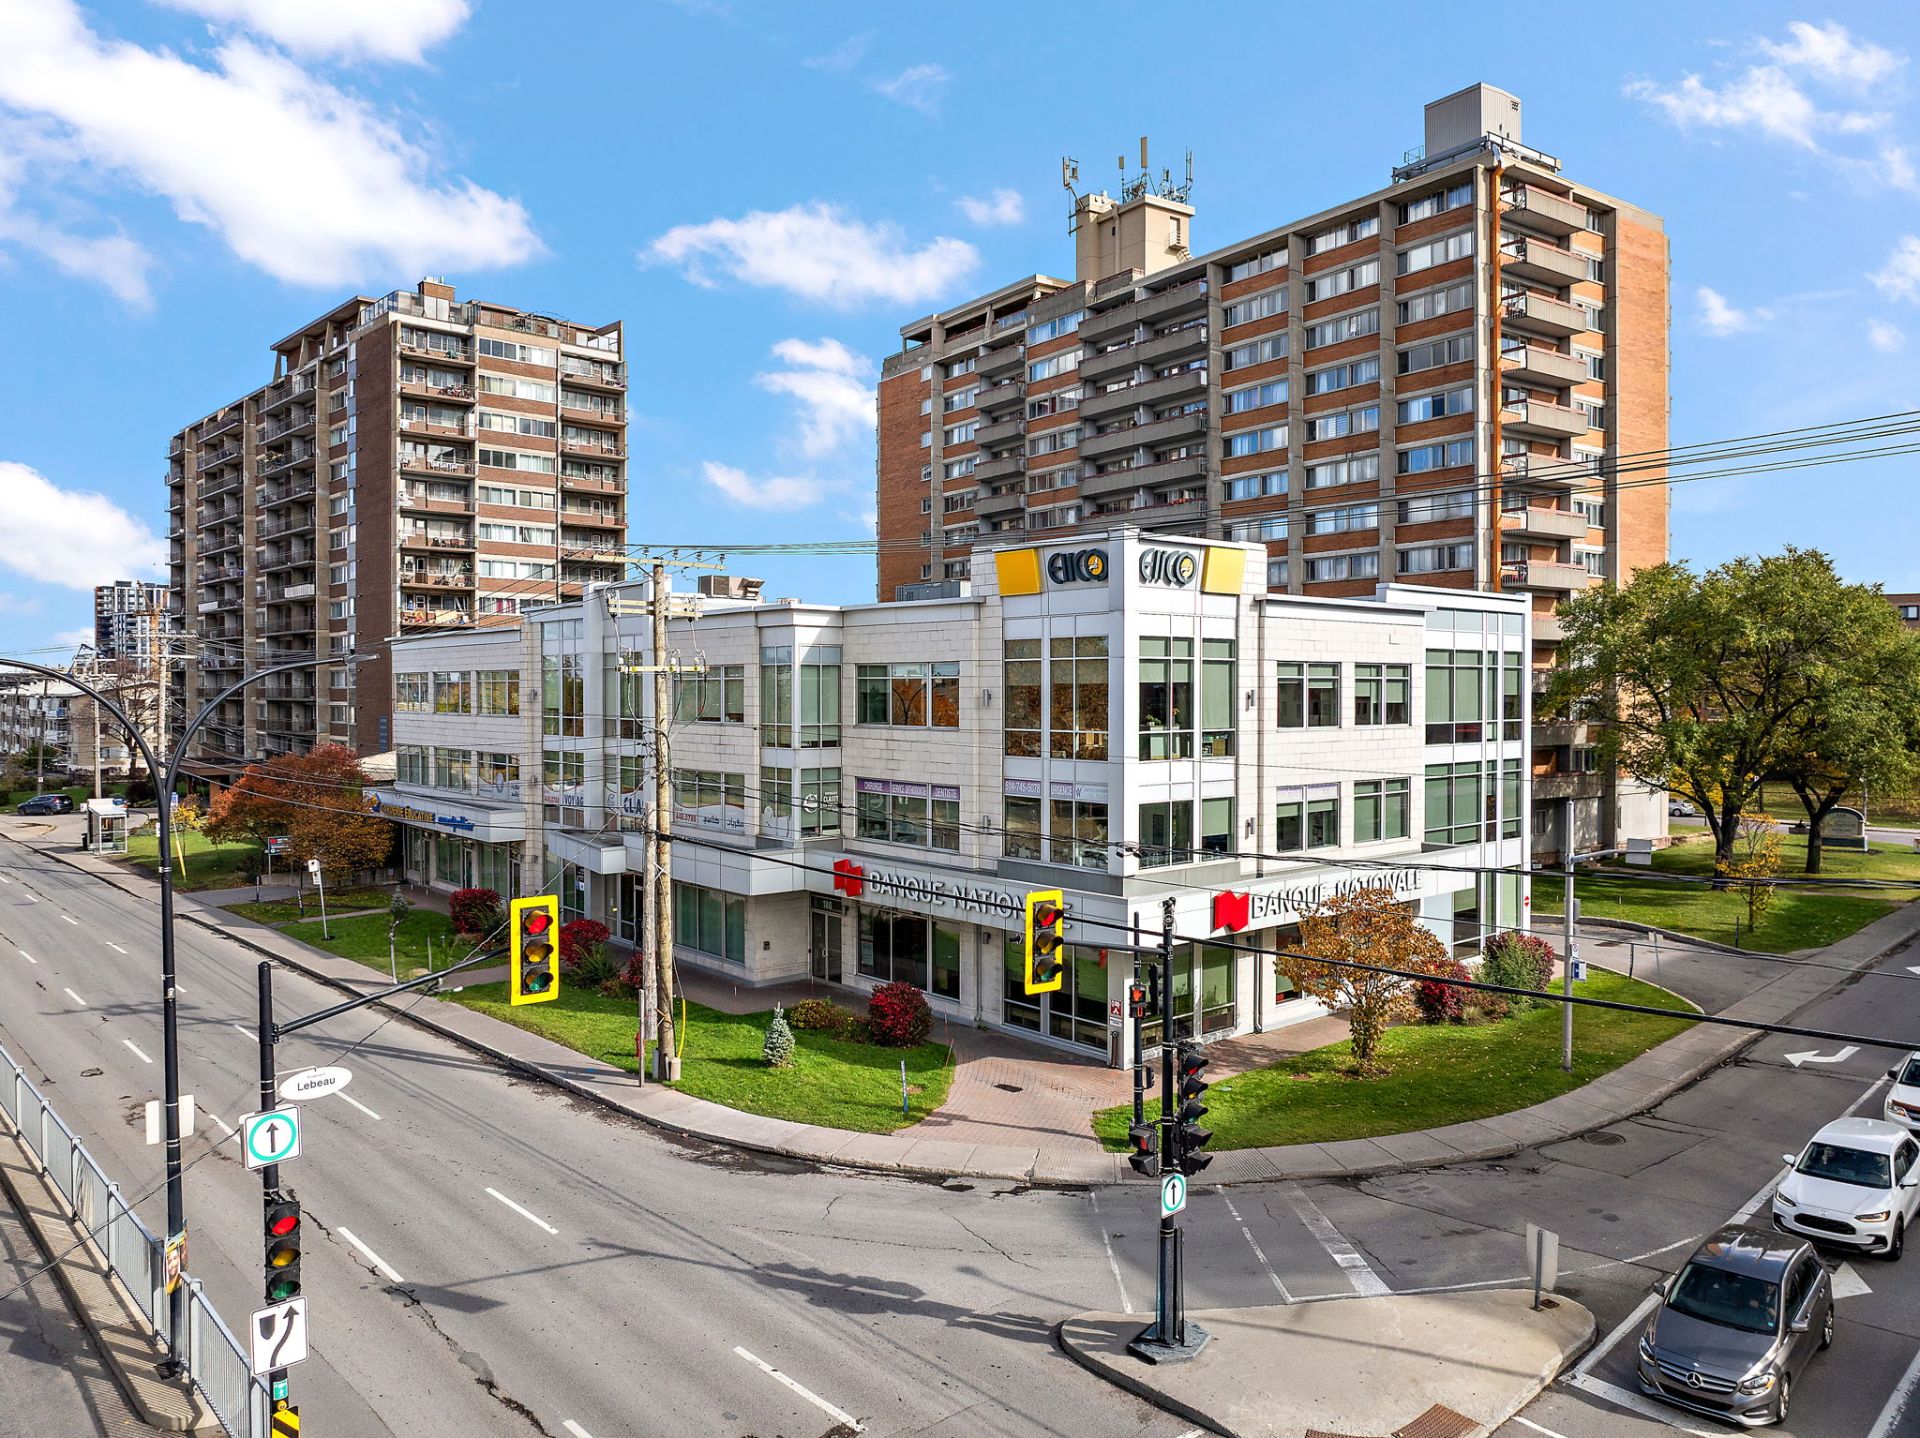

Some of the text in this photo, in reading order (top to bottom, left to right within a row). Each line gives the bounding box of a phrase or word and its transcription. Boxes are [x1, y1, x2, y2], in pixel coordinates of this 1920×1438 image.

[1051, 783, 1072, 796] URGENCE
[869, 871, 945, 906] BANQUE
[1252, 882, 1330, 918] BANQUE
[297, 1077, 336, 1092] Lebeau
